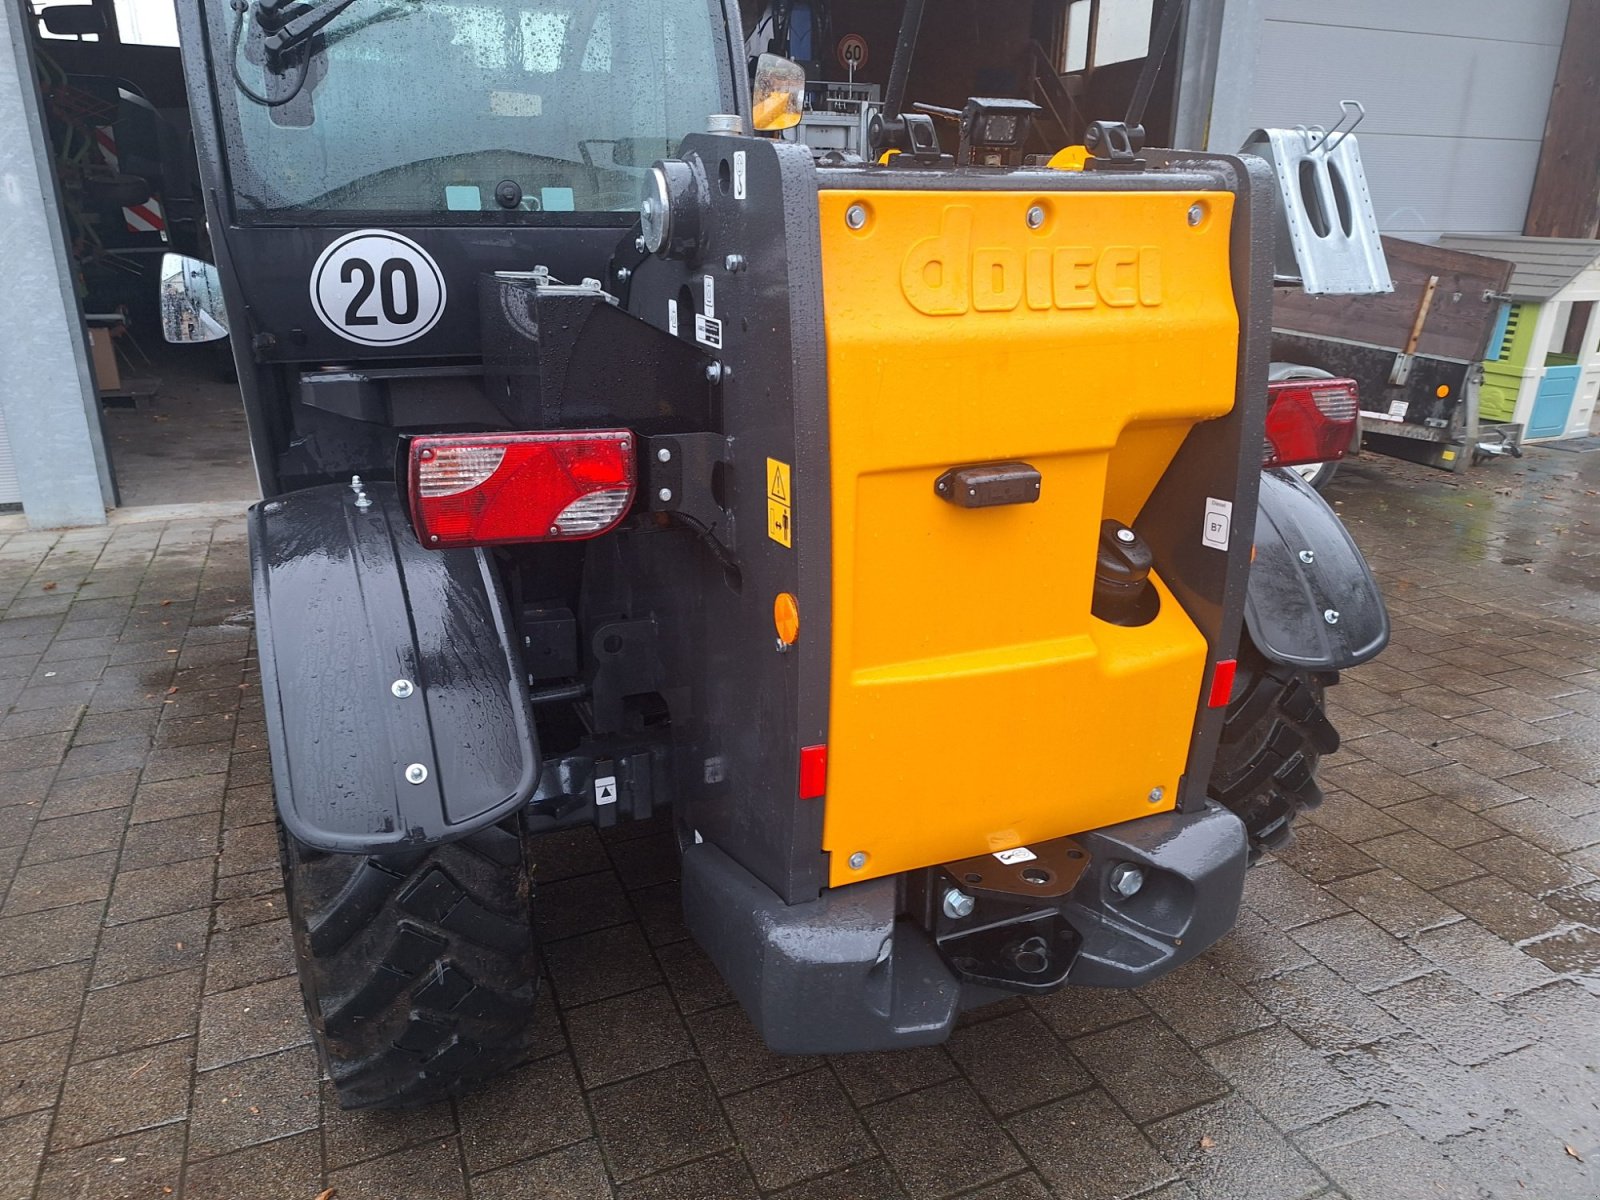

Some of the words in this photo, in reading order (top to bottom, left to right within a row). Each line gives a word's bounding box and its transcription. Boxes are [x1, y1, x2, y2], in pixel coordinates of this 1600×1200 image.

[845, 44, 861, 61] 60
[340, 257, 419, 326] 20
[1211, 522, 1222, 533] B7
